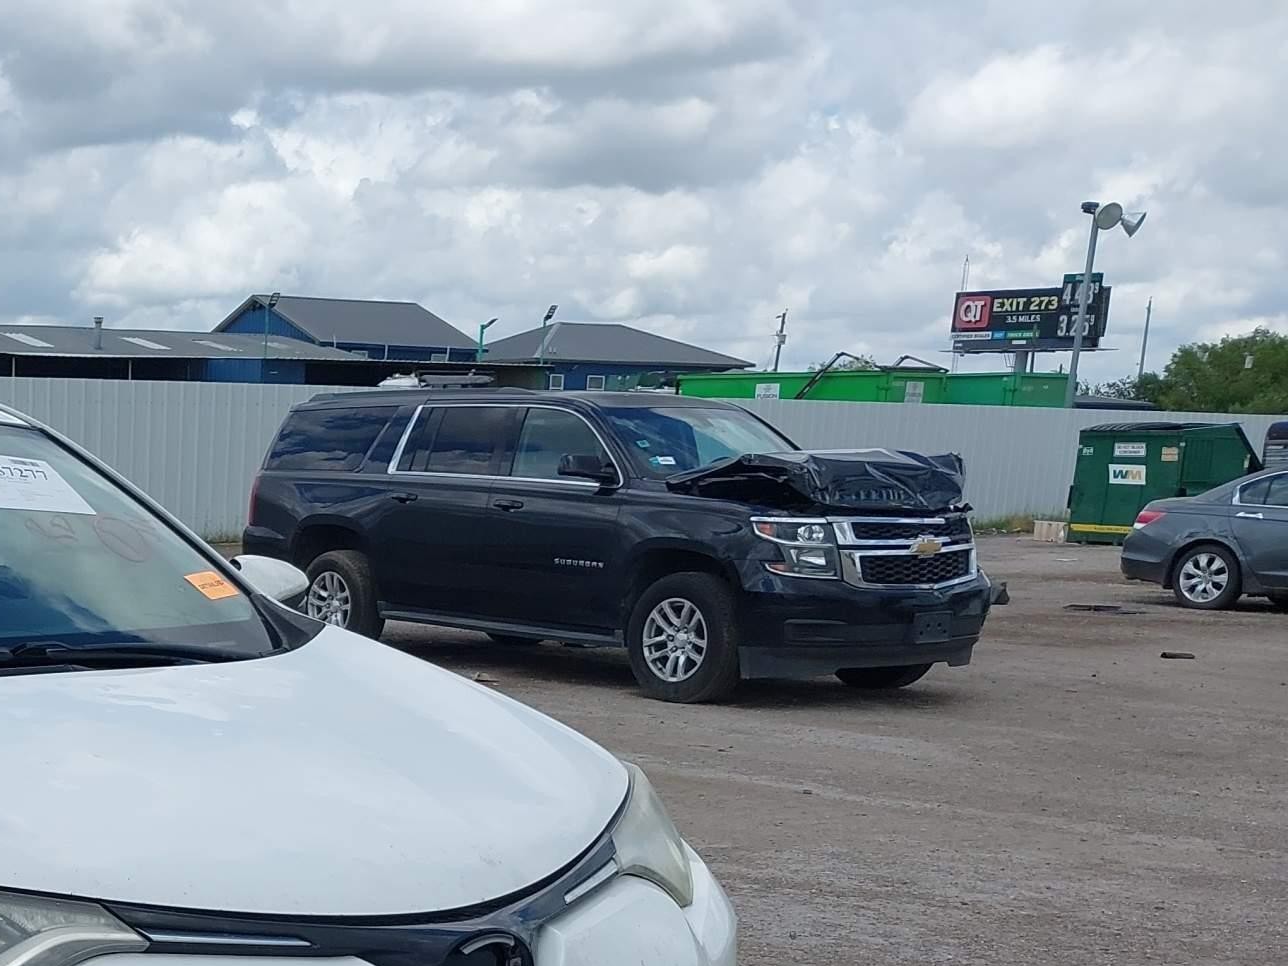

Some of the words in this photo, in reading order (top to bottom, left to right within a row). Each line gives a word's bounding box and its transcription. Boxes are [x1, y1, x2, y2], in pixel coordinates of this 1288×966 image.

[993, 297, 1027, 312] EXIT
[1029, 296, 1058, 311] 273
[959, 300, 985, 324] QT
[1018, 314, 1040, 323] MILES
[1113, 469, 1142, 480] WM
[553, 557, 605, 569] SUBURBAN
